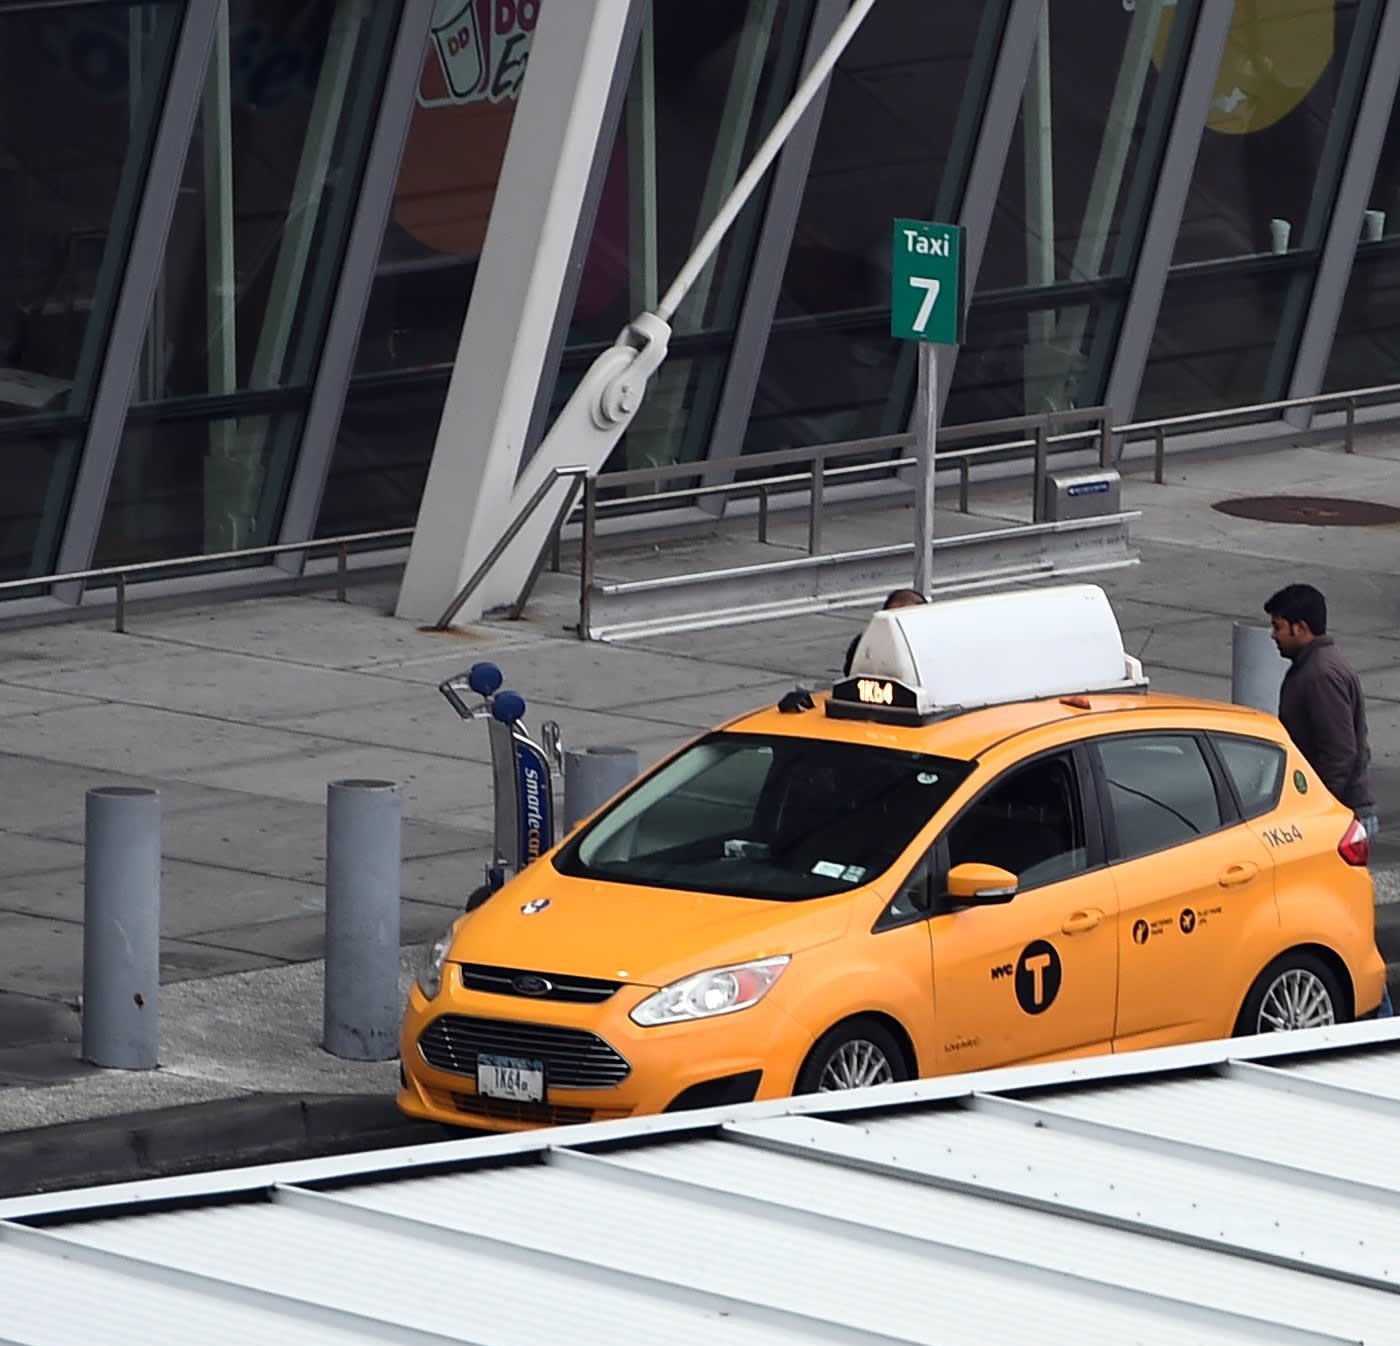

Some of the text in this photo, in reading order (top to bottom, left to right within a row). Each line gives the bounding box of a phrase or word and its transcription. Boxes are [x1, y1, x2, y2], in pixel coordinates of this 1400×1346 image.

[903, 229, 950, 257] Taxi
[909, 276, 941, 333] 7
[523, 766, 544, 864] smartecar
[991, 963, 1014, 981] NYC
